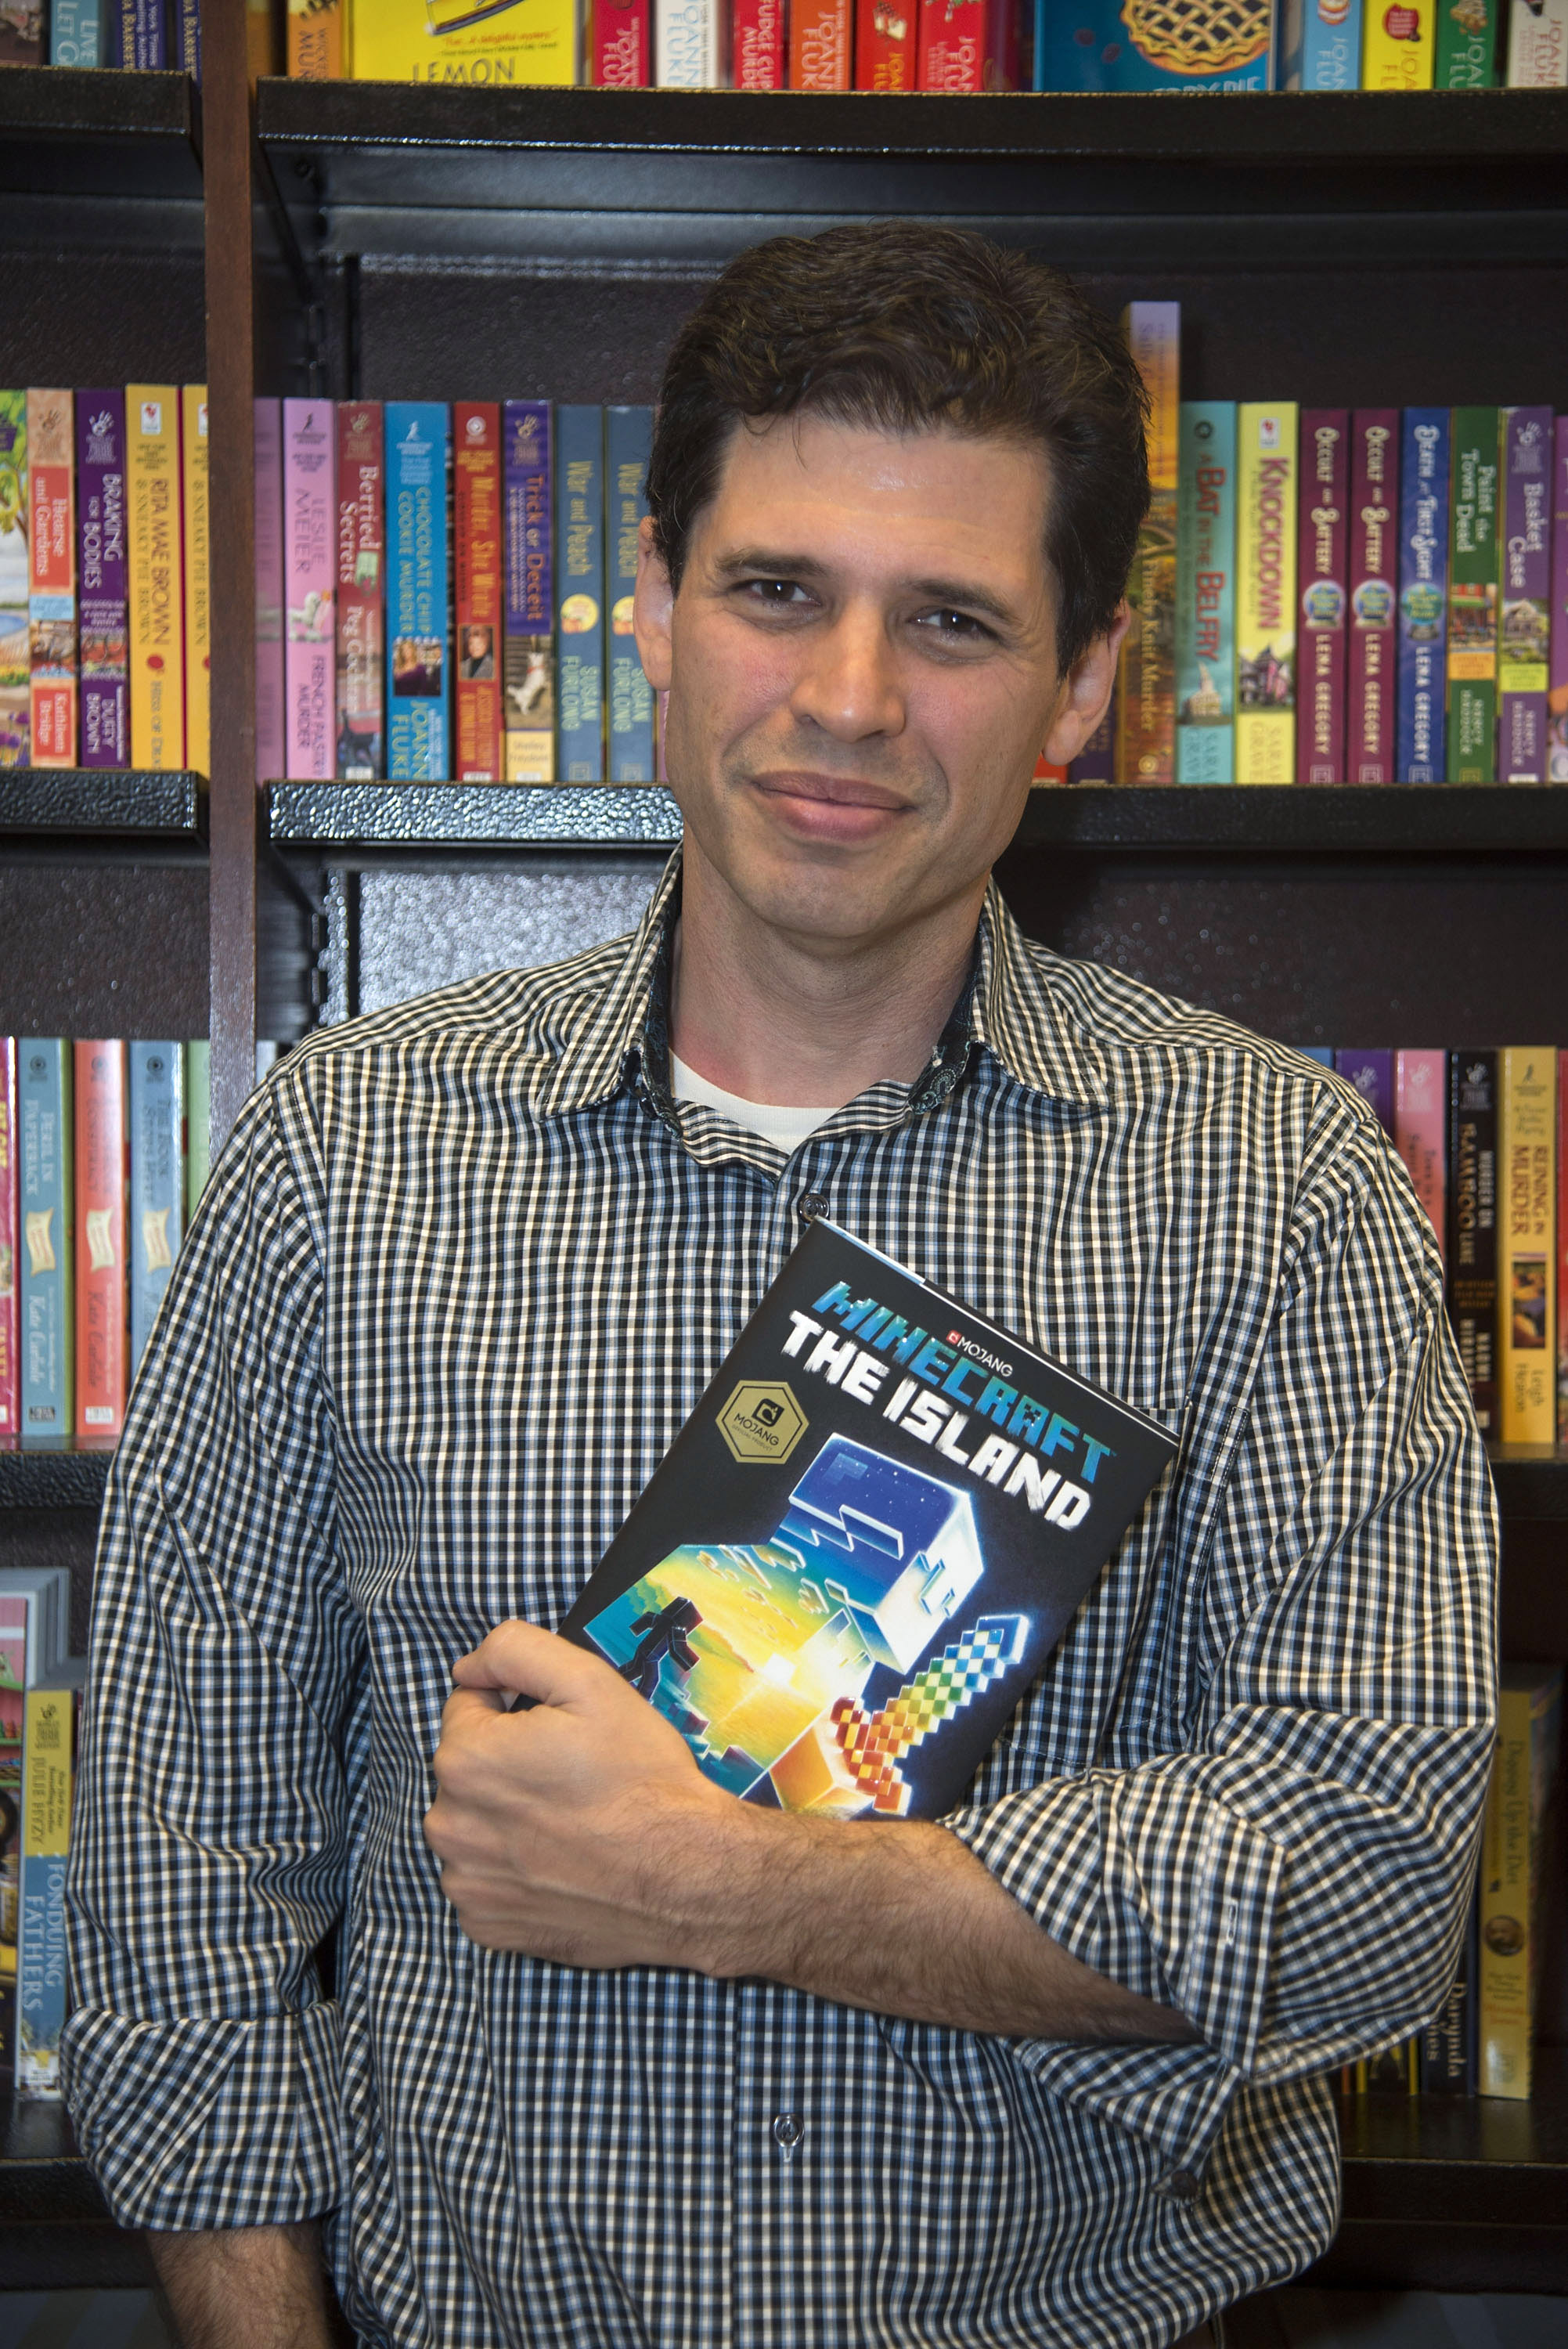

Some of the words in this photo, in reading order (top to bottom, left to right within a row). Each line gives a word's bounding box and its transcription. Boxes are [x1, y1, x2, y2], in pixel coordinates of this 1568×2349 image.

[56, 2, 78, 36] LET
[80, 20, 99, 62] LIVE
[36, 477, 49, 503] and
[150, 478, 171, 515] RITA
[526, 474, 546, 524] Trick
[567, 460, 596, 494] War
[617, 463, 645, 496] War
[1460, 448, 1481, 500] Town
[1477, 464, 1498, 514] Paint
[52, 498, 67, 557] Hearse
[103, 474, 124, 561] BRAKING
[137, 494, 150, 552] SNEAKY
[193, 495, 207, 553] SNEAKY
[295, 488, 310, 574] MEIER
[312, 498, 326, 564] LESLIE
[359, 465, 382, 549] Berried
[398, 492, 414, 555] COOKIE
[570, 499, 588, 521] and
[620, 500, 638, 524] and
[1455, 503, 1478, 553] Dead
[1475, 518, 1491, 543] the
[1523, 482, 1548, 552] Basket
[35, 506, 50, 576] Gardens
[83, 522, 101, 589] BODIES
[151, 519, 171, 561] MAE
[339, 501, 359, 584] Secrets
[416, 486, 431, 588] CHOCOLATE
[470, 540, 496, 570] She
[526, 528, 541, 547] or
[567, 525, 596, 576] Peach
[1258, 456, 1291, 630] KNOCKDOWN
[1508, 536, 1527, 589] Case
[152, 567, 172, 644] BROWN
[398, 559, 415, 635] MURDER
[416, 592, 433, 634] CHIP
[526, 553, 545, 620] Deceit
[1138, 560, 1159, 615] Finely
[138, 589, 150, 644] BROWN
[195, 589, 207, 644] BROWN
[341, 606, 365, 637] Peg
[1141, 620, 1159, 660] Knit
[1314, 634, 1332, 677] LENA
[1364, 633, 1382, 676] LENA
[1415, 646, 1433, 688] LENA
[312, 655, 325, 717] FRENCH
[561, 655, 581, 731] FURLONG
[580, 666, 599, 721] SUSAN
[613, 657, 633, 733] FURLONG
[632, 667, 651, 722] SUSAN
[1140, 665, 1160, 731] Murder
[55, 693, 67, 752] Kathleen
[86, 693, 102, 754] BROWN
[101, 698, 116, 749] DUFFY
[297, 684, 310, 748] MURDER
[411, 701, 429, 779] JOANN
[1314, 682, 1332, 755] GREGORY
[1364, 681, 1382, 754] GREGORY
[1413, 692, 1432, 763] GREGORY
[312, 721, 325, 777] PASTRY
[392, 715, 409, 778] FLUKE
[24, 1099, 39, 1196] PAPERBACK
[41, 1111, 55, 1158] PERIL
[1457, 1122, 1477, 1230] BAMBOO
[1477, 1149, 1494, 1207] MURDER
[1511, 1144, 1530, 1236] MURDER
[1532, 1144, 1549, 1218] REINING
[1477, 1208, 1494, 1229] ON
[1458, 1232, 1476, 1265] LANE
[28, 1295, 46, 1327] Kate
[87, 1292, 105, 1326] Kate
[29, 1331, 47, 1385] Carlisle
[811, 1279, 1114, 1485] MINECRAFT
[957, 1335, 1014, 1377] MOJANG
[1475, 1333, 1491, 1382] NAOMI
[734, 1413, 780, 1446] MOJANG
[781, 1309, 890, 1406] THE
[882, 1375, 1093, 1532] ISLAND
[31, 1756, 46, 1797] JULIE
[31, 1802, 46, 1844] HYZY
[45, 1863, 66, 1988] FONDUING
[22, 1895, 45, 2012] FATHERS
[1440, 1983, 1467, 2077] Darynda
